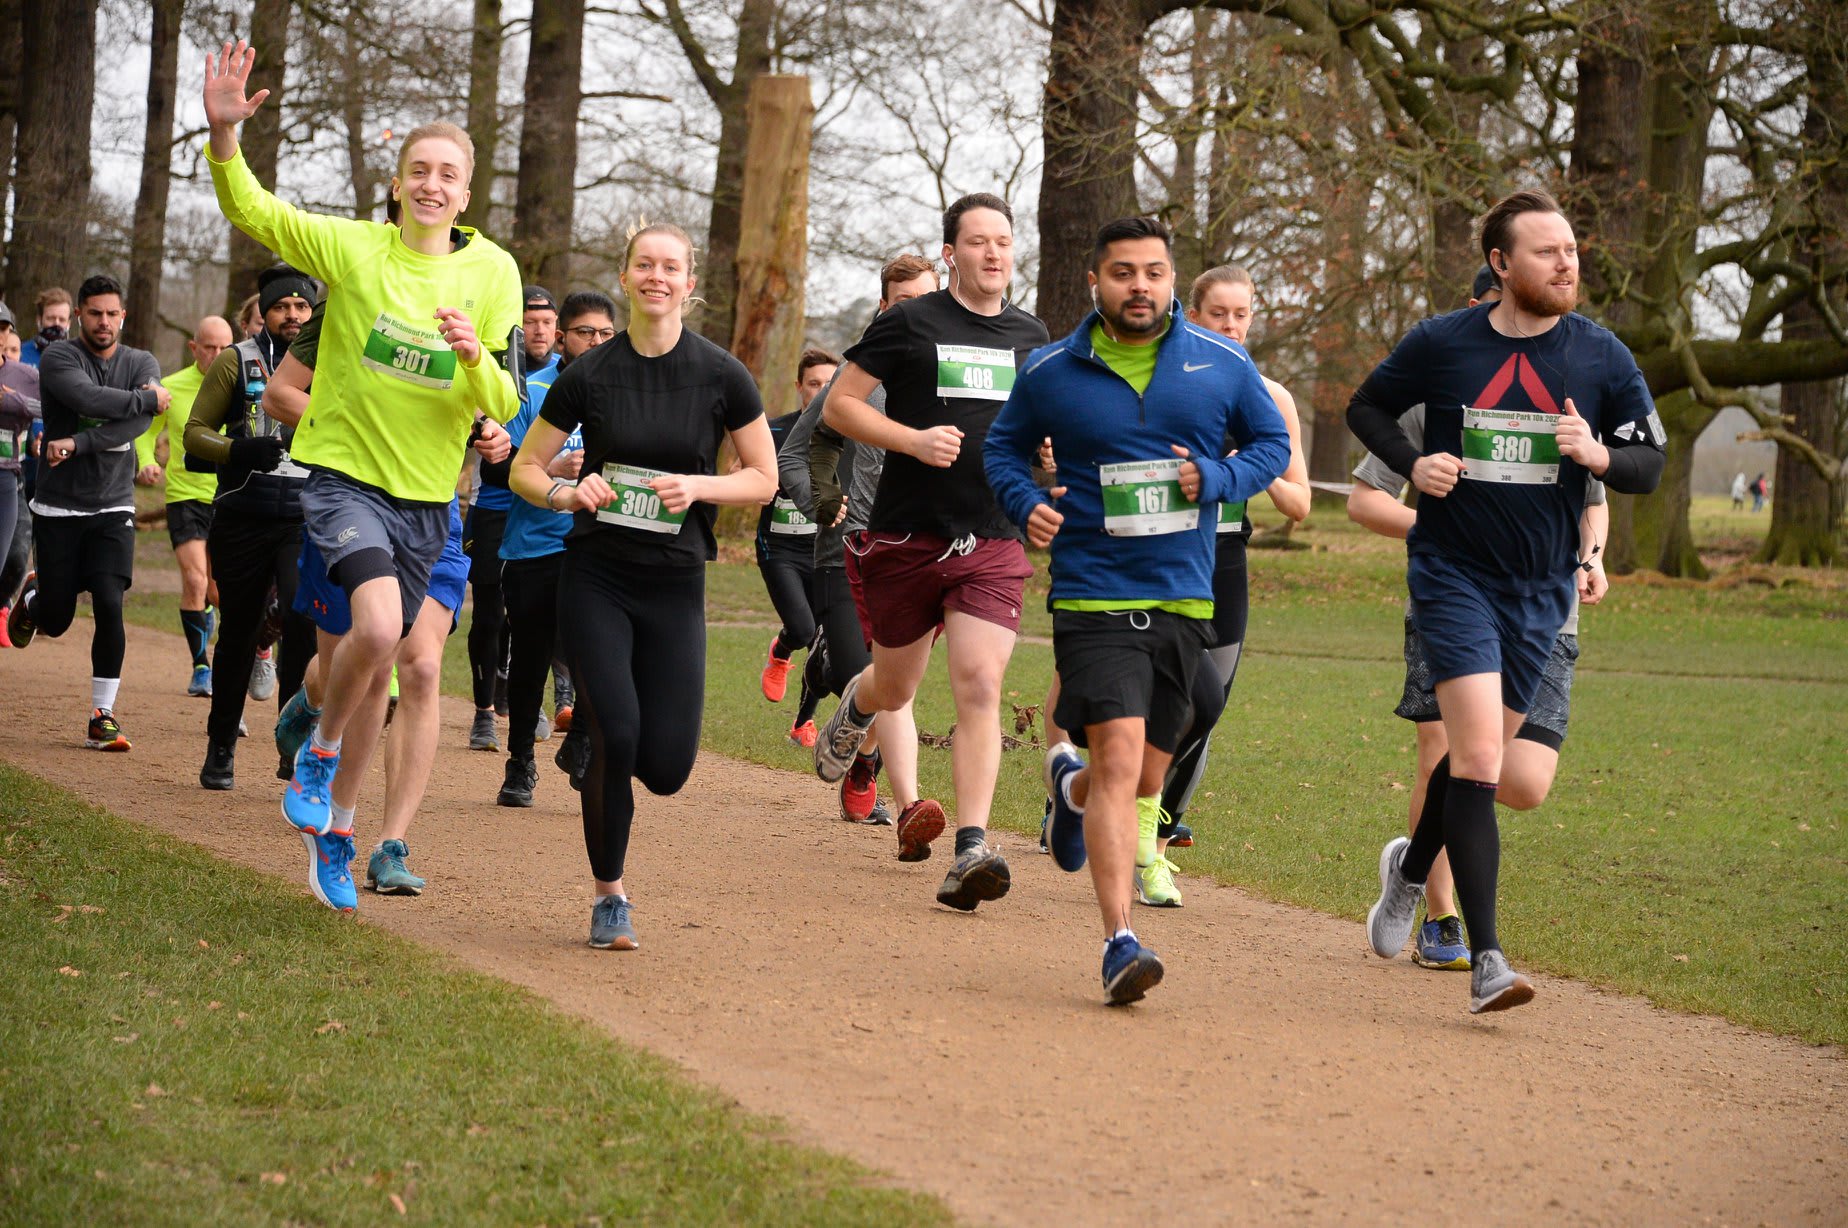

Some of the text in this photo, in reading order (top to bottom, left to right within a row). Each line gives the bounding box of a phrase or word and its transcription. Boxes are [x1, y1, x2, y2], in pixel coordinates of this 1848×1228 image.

[380, 313, 392, 324] Run
[391, 319, 421, 336] Richmond
[420, 331, 435, 340] Park
[393, 345, 431, 375] 301
[952, 347, 977, 355] Richmond
[963, 366, 994, 390] 408
[1467, 409, 1480, 418] Run
[1481, 411, 1515, 420] Richmond
[1516, 413, 1531, 421] Park
[1532, 414, 1543, 422] 10k
[1491, 434, 1532, 463] 380
[616, 465, 648, 477] Richmond
[1103, 465, 1116, 473] Run
[1117, 463, 1151, 472] Richmond
[1151, 462, 1167, 470] Park
[1501, 474, 1512, 482] 380
[621, 490, 661, 520] 300
[1135, 486, 1169, 514] 167
